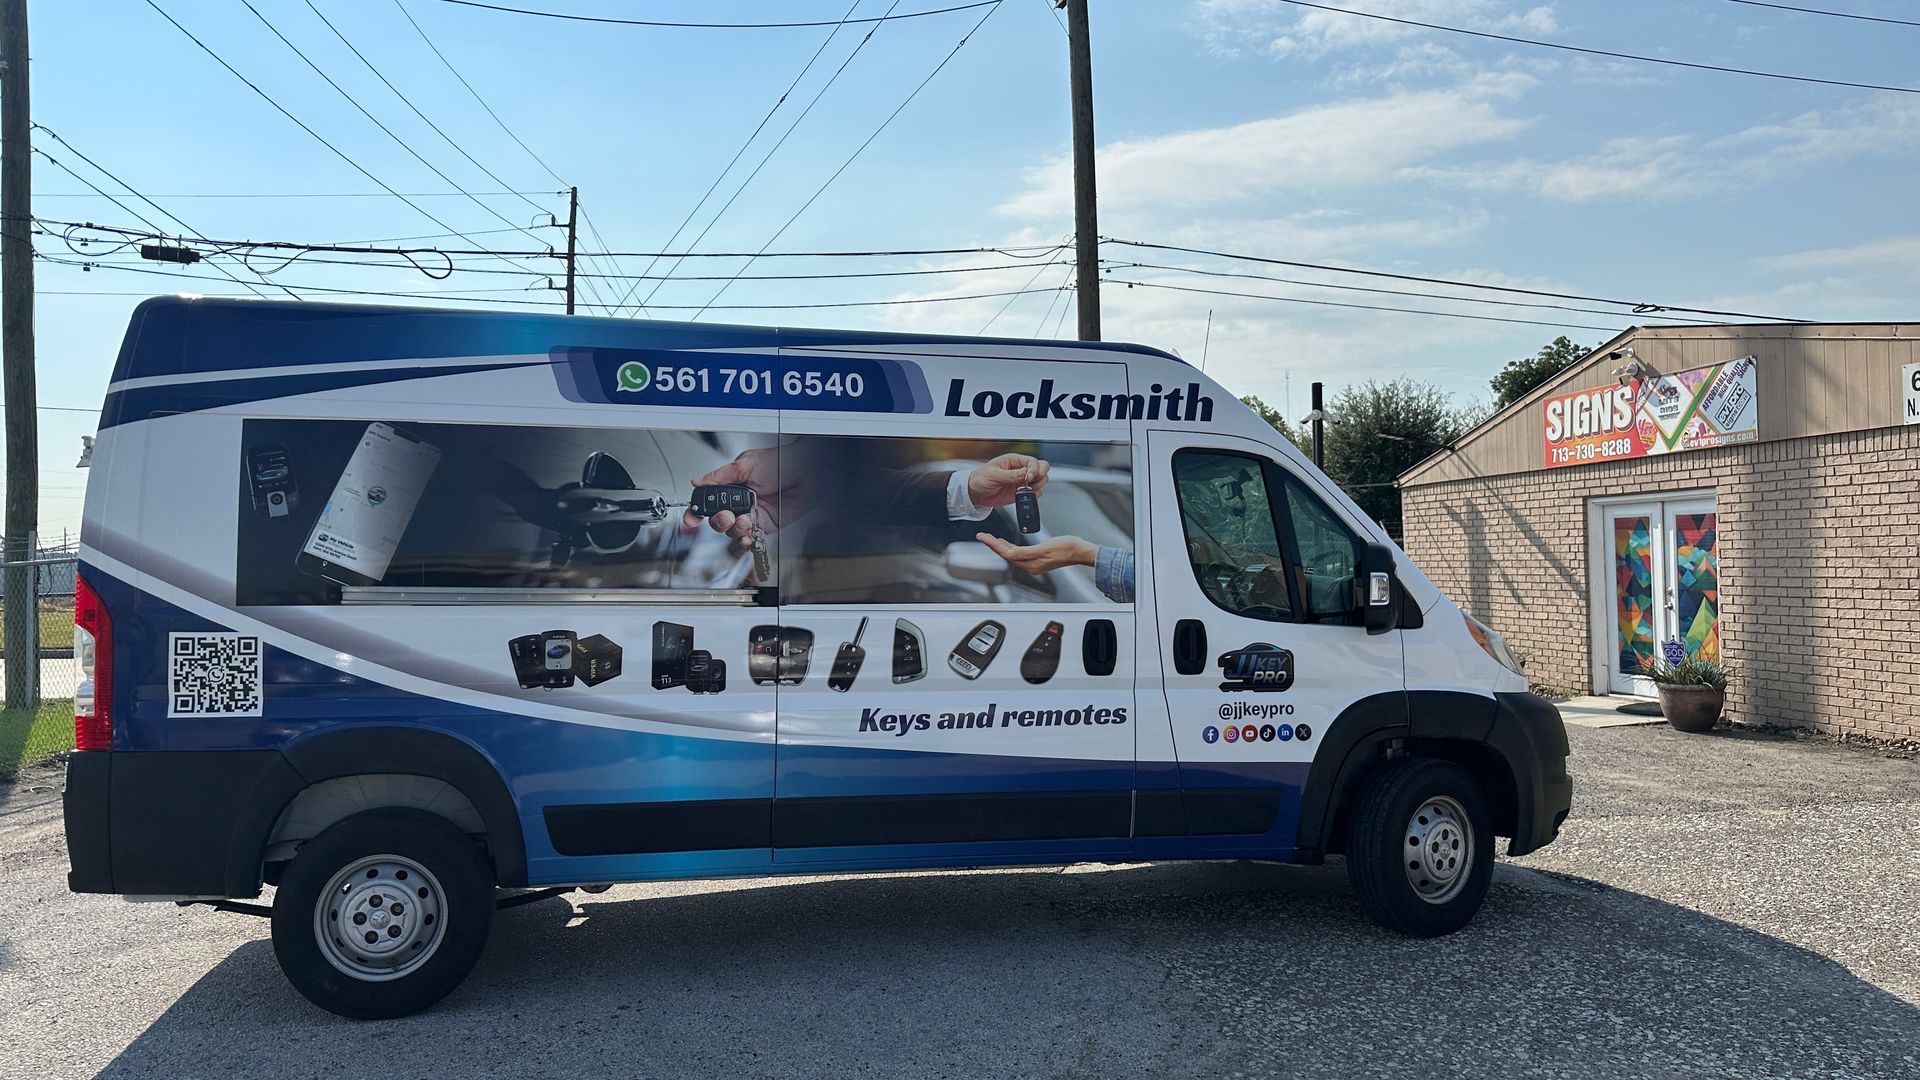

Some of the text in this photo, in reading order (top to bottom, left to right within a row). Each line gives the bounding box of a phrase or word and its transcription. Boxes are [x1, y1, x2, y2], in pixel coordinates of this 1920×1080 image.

[655, 366, 864, 398] 561 701 6540
[1702, 370, 1728, 412] AFFORDABLE
[1718, 361, 1743, 399] HIGH QUALITY
[944, 379, 1214, 422] Locksmith
[1546, 386, 1633, 441] SIGNS
[1551, 438, 1631, 463] 713-730-8288
[1256, 657, 1288, 671] KEY
[1665, 648, 1684, 657] GOD
[1252, 670, 1288, 684] PRO
[858, 704, 1128, 737] Keys and remotes
[1219, 701, 1295, 721] @jjkeypro
